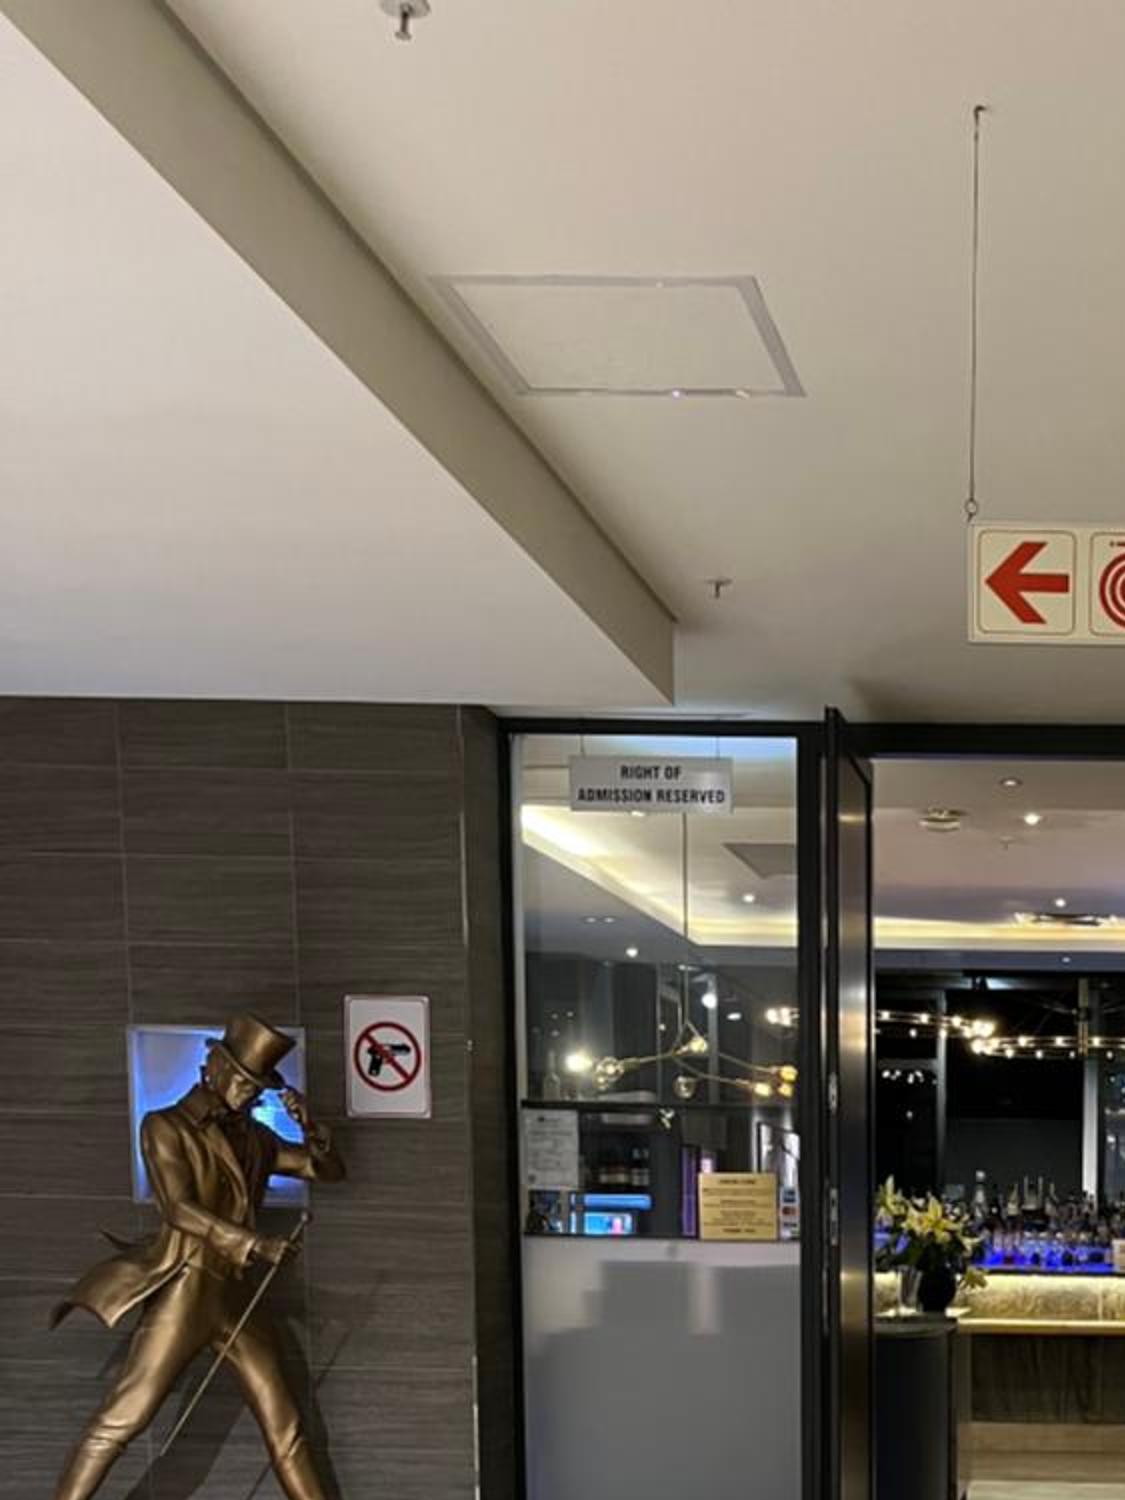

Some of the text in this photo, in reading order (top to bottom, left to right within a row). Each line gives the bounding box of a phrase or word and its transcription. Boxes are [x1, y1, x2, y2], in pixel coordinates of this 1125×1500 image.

[620, 764, 682, 780] RIGHT OF
[577, 787, 725, 804] ADMISSION RESERVED
